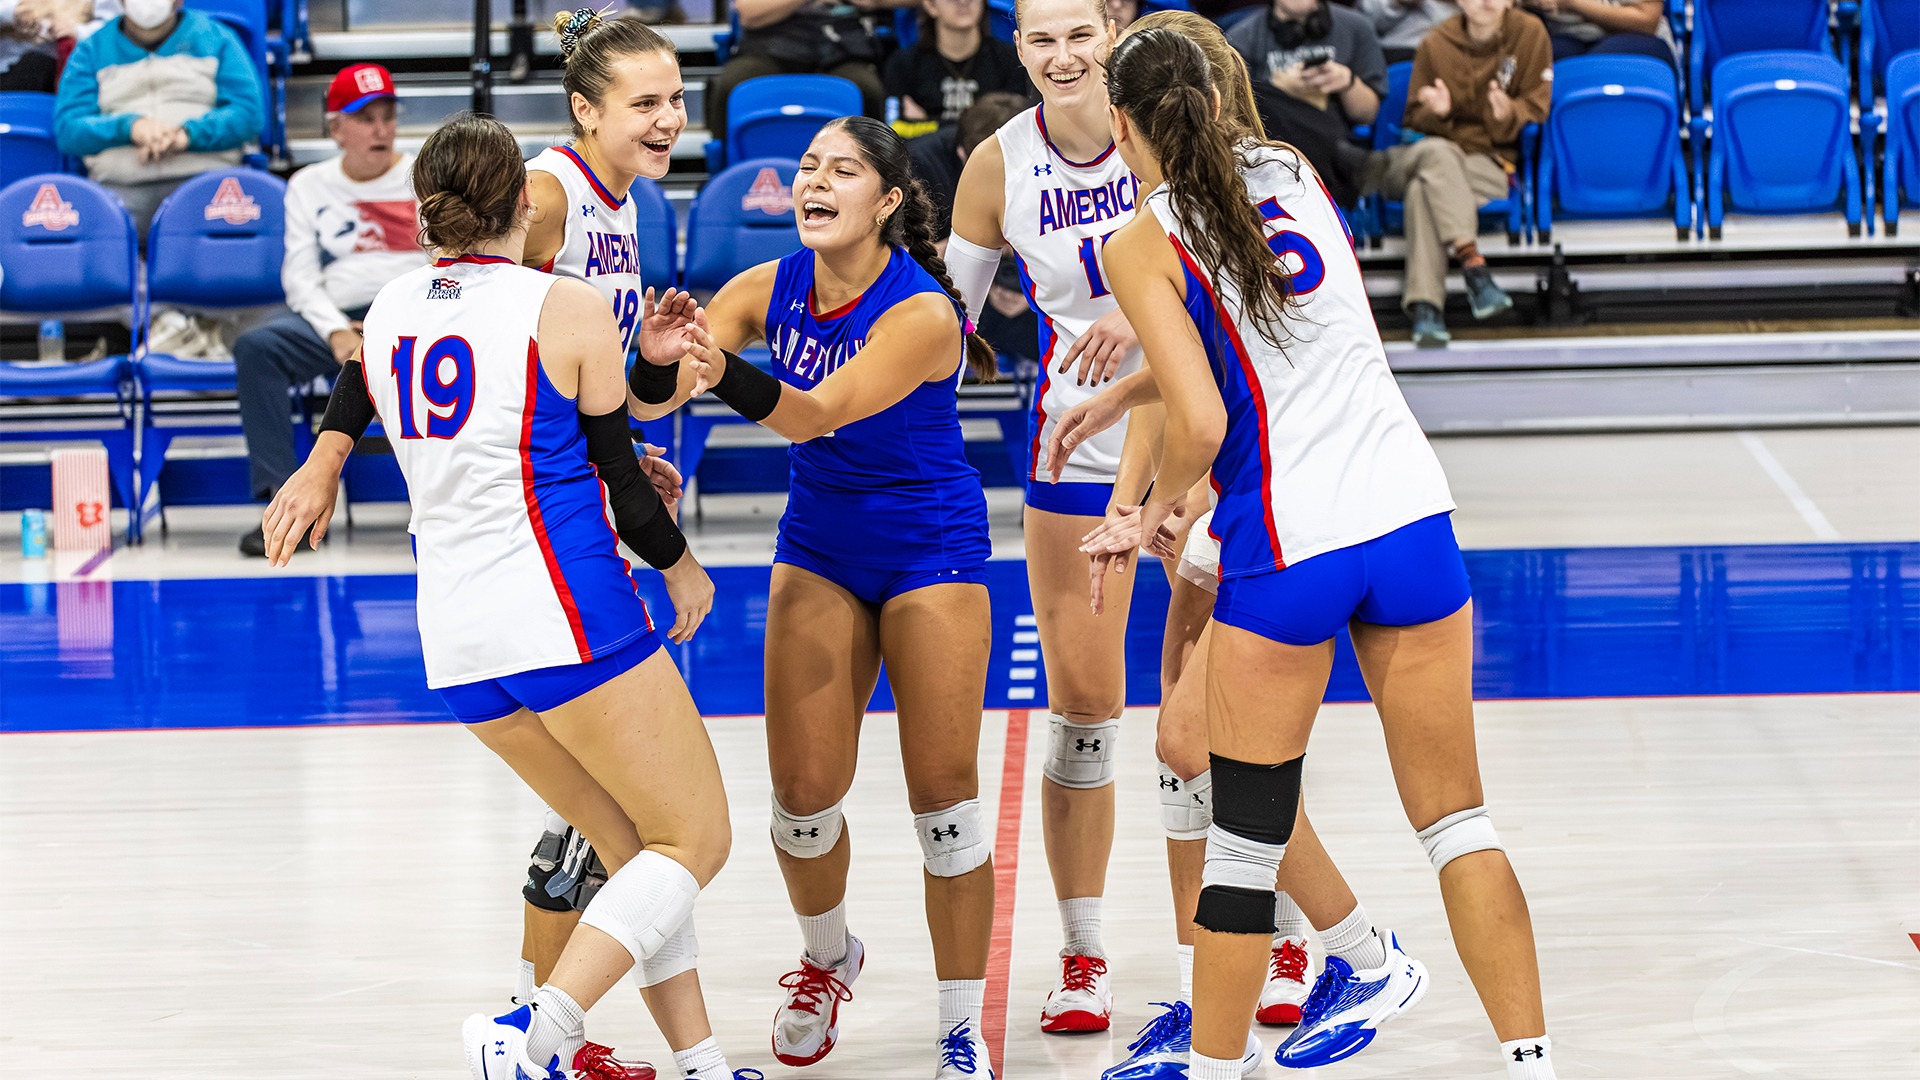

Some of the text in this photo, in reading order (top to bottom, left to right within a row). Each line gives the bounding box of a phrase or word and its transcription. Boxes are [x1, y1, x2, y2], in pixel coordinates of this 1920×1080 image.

[428, 287, 462, 295] PATRIOT
[1078, 229, 1118, 299] 1
[391, 335, 476, 440] 19
